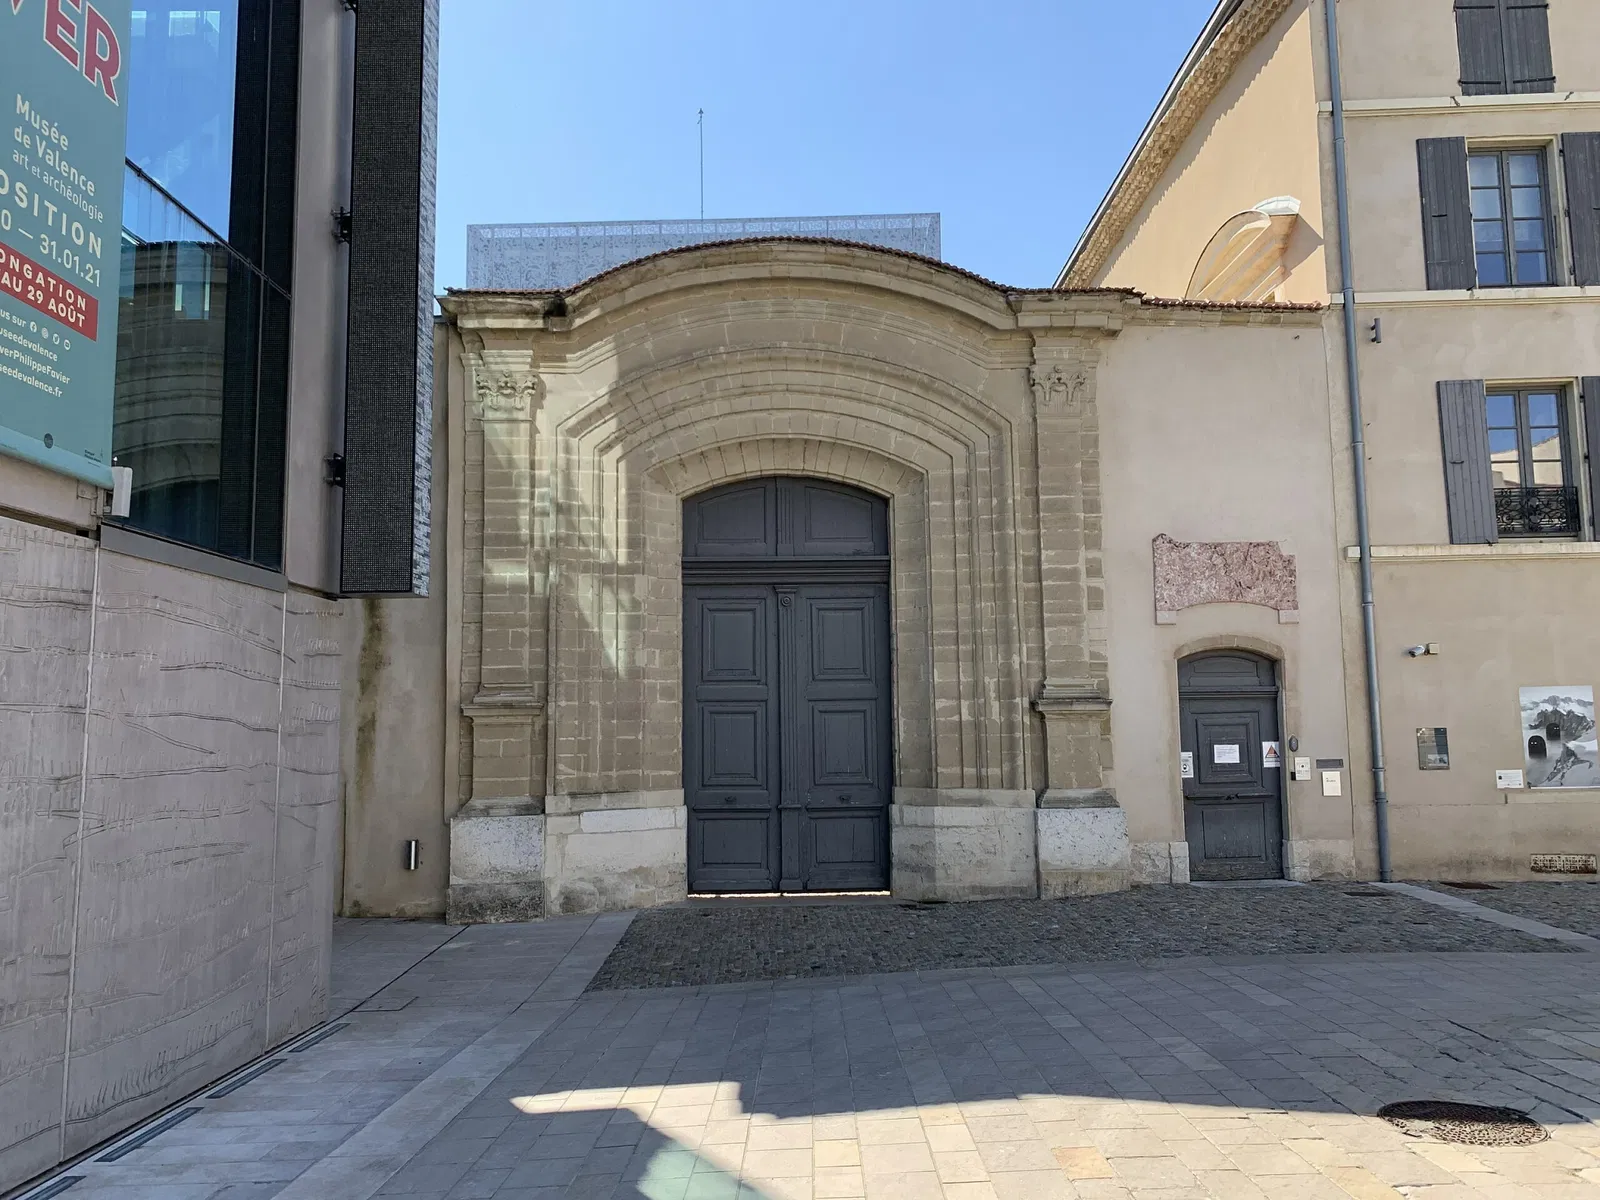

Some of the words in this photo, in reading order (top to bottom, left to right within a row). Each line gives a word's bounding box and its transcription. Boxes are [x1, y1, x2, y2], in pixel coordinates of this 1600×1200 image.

[10, 0, 121, 106] ER
[16, 93, 69, 151] Musée
[13, 149, 29, 170] art
[31, 165, 40, 178] et
[43, 171, 103, 223] archéologie
[14, 126, 31, 149] de
[35, 135, 95, 196] Valence
[1, 209, 11, 231] 0
[40, 233, 100, 288] 31.01.21
[12, 315, 26, 327] sur
[27, 285, 43, 304] 29
[48, 298, 85, 327] AOÛT
